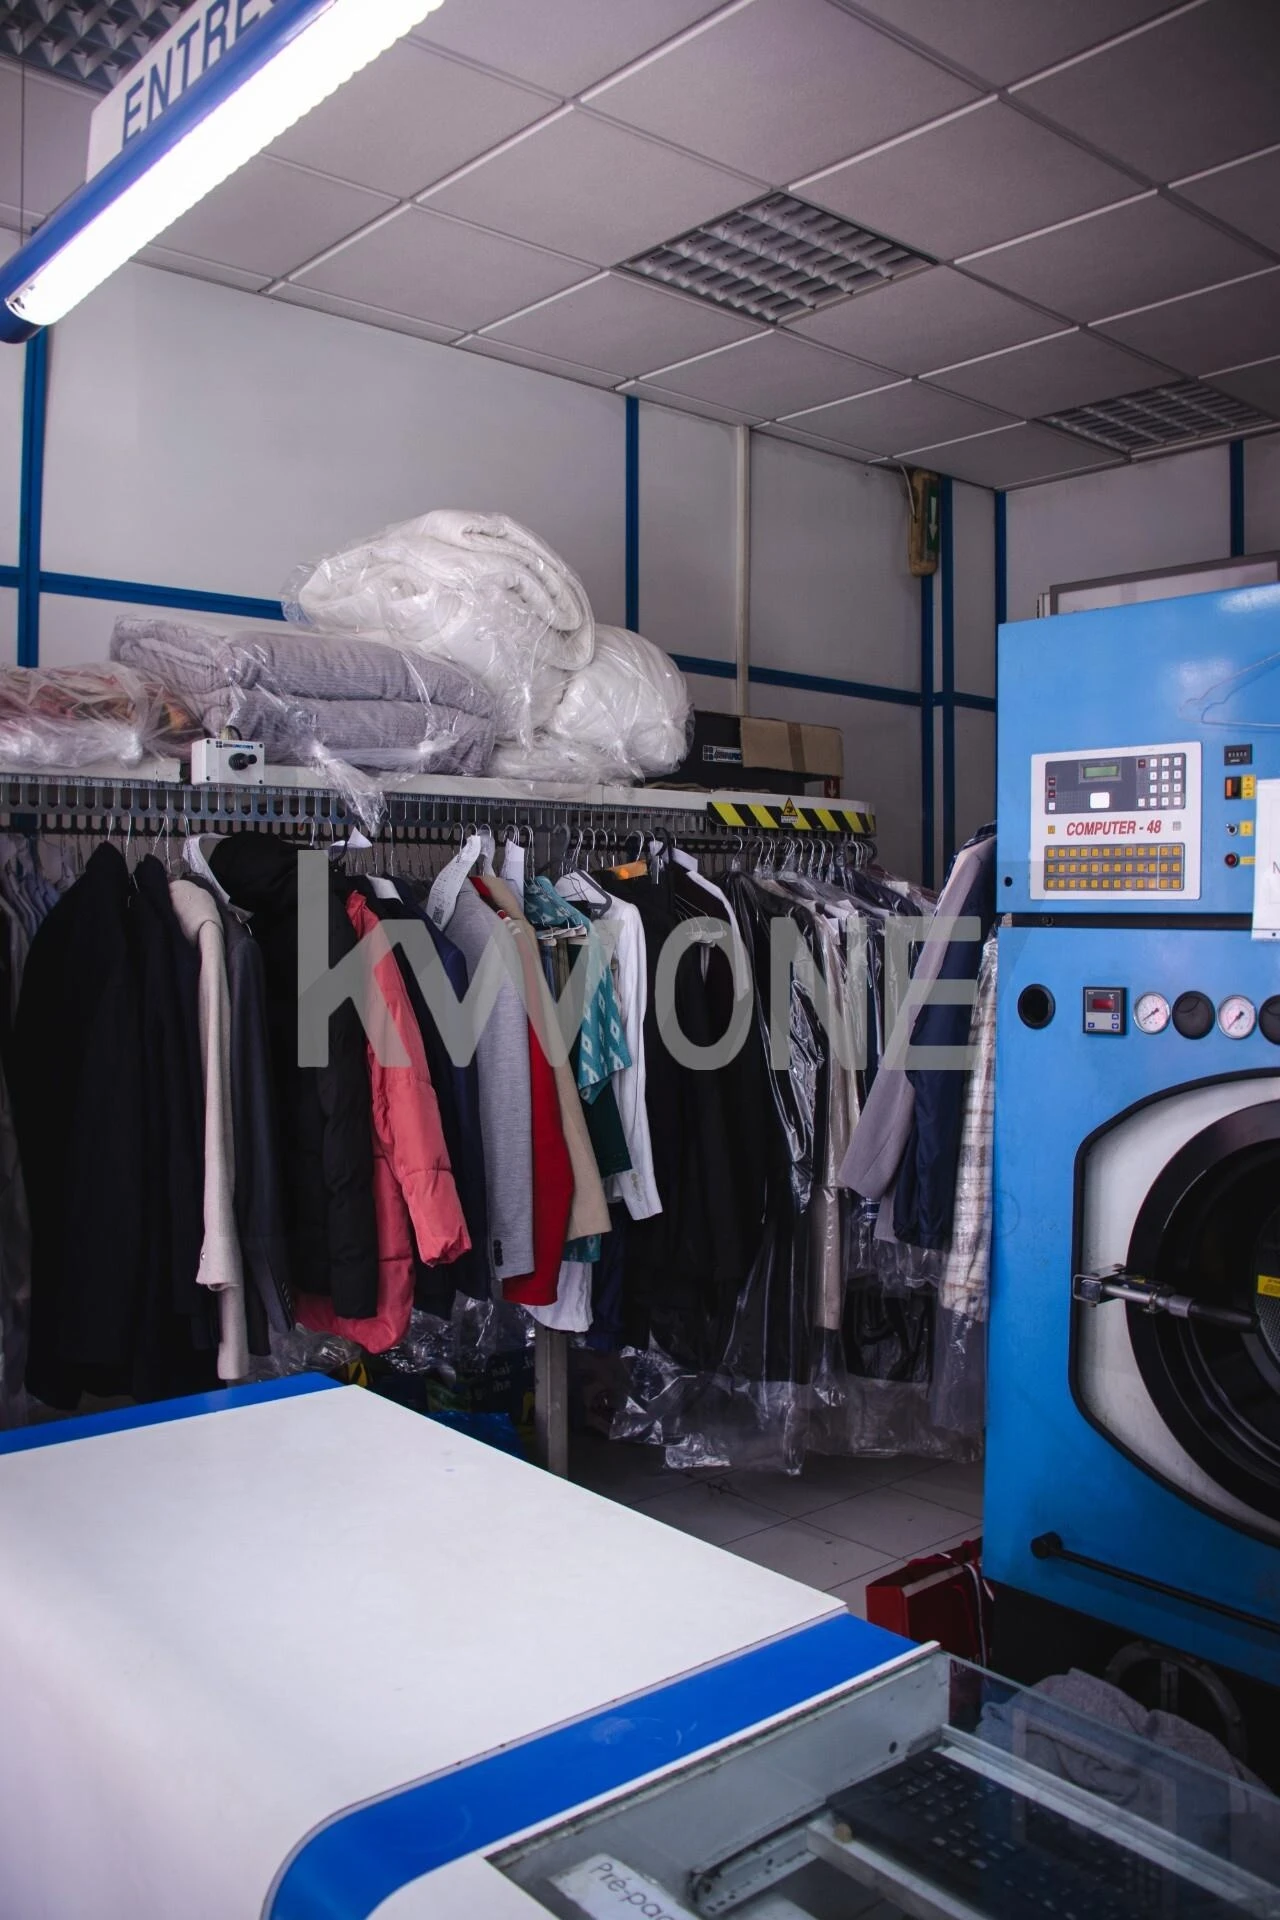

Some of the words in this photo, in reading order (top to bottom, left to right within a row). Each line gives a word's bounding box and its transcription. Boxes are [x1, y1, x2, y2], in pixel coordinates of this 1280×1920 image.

[122, 0, 278, 146] ENTRE
[1066, 821, 1137, 836] COMPUTER
[1146, 820, 1162, 834] 48
